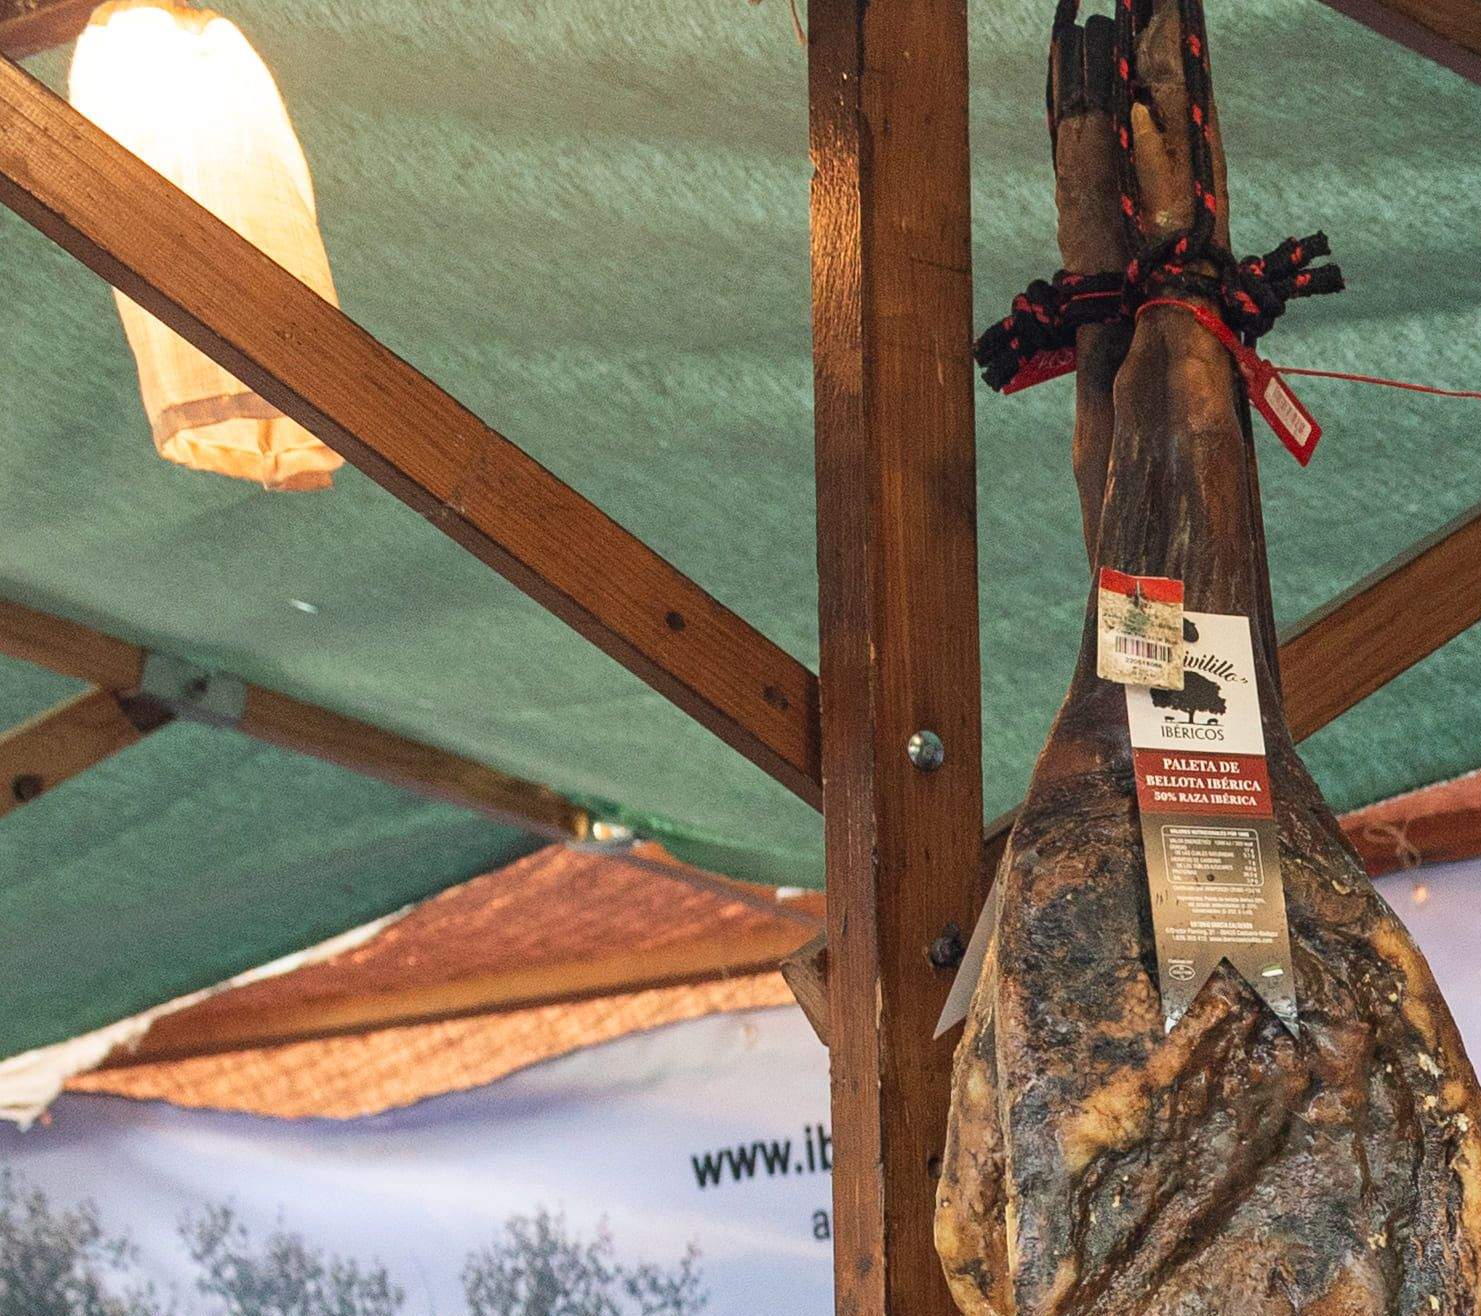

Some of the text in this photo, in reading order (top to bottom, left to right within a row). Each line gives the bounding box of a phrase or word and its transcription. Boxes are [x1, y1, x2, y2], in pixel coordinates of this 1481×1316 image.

[1161, 724, 1225, 742] IBÉRICOS
[1162, 757, 1240, 774] PALETA DE
[1145, 774, 1261, 792] BELLOTA IBÉRICA
[1154, 791, 1257, 806] 50% RAZA IBÉRICA
